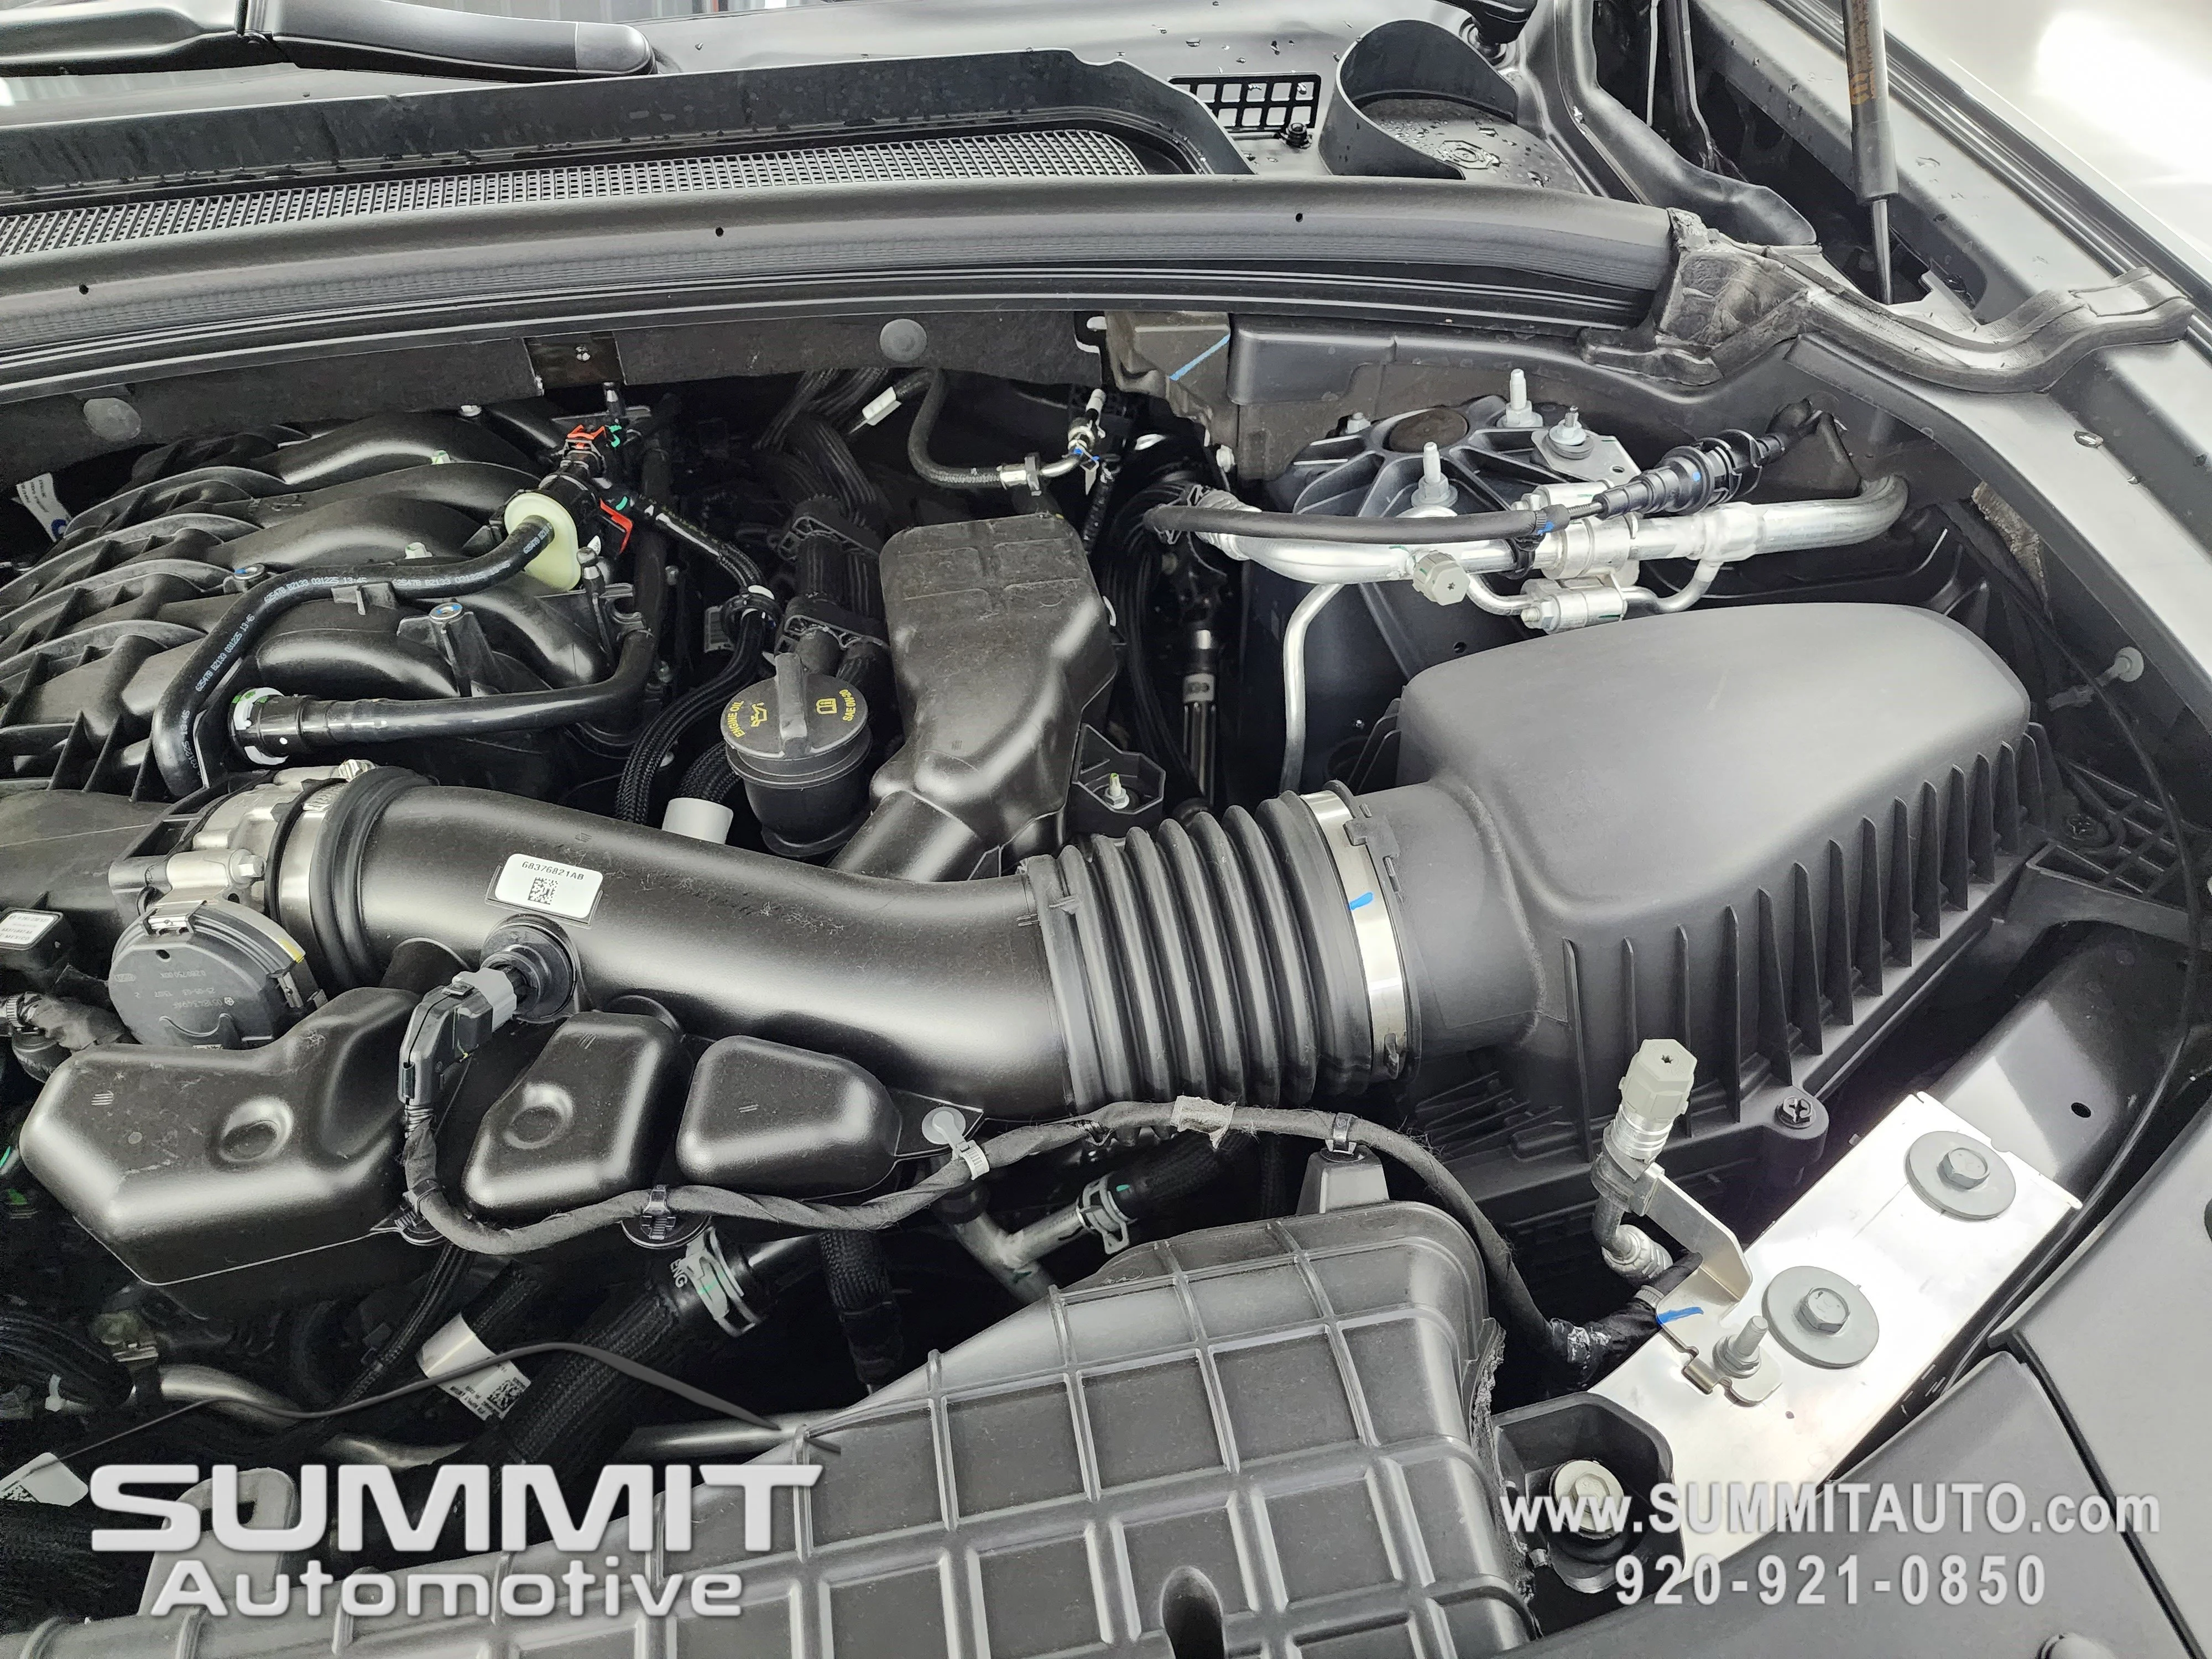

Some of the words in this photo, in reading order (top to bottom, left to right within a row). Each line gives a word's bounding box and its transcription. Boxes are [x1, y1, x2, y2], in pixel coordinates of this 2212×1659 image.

[224, 631, 243, 654] 031225
[729, 701, 745, 712] OIL
[839, 689, 856, 707] 0W-20
[842, 707, 856, 722] SAE
[727, 712, 746, 738] ENGINE
[521, 861, 585, 880] 68376821AB
[670, 1258, 688, 1288] ENG
